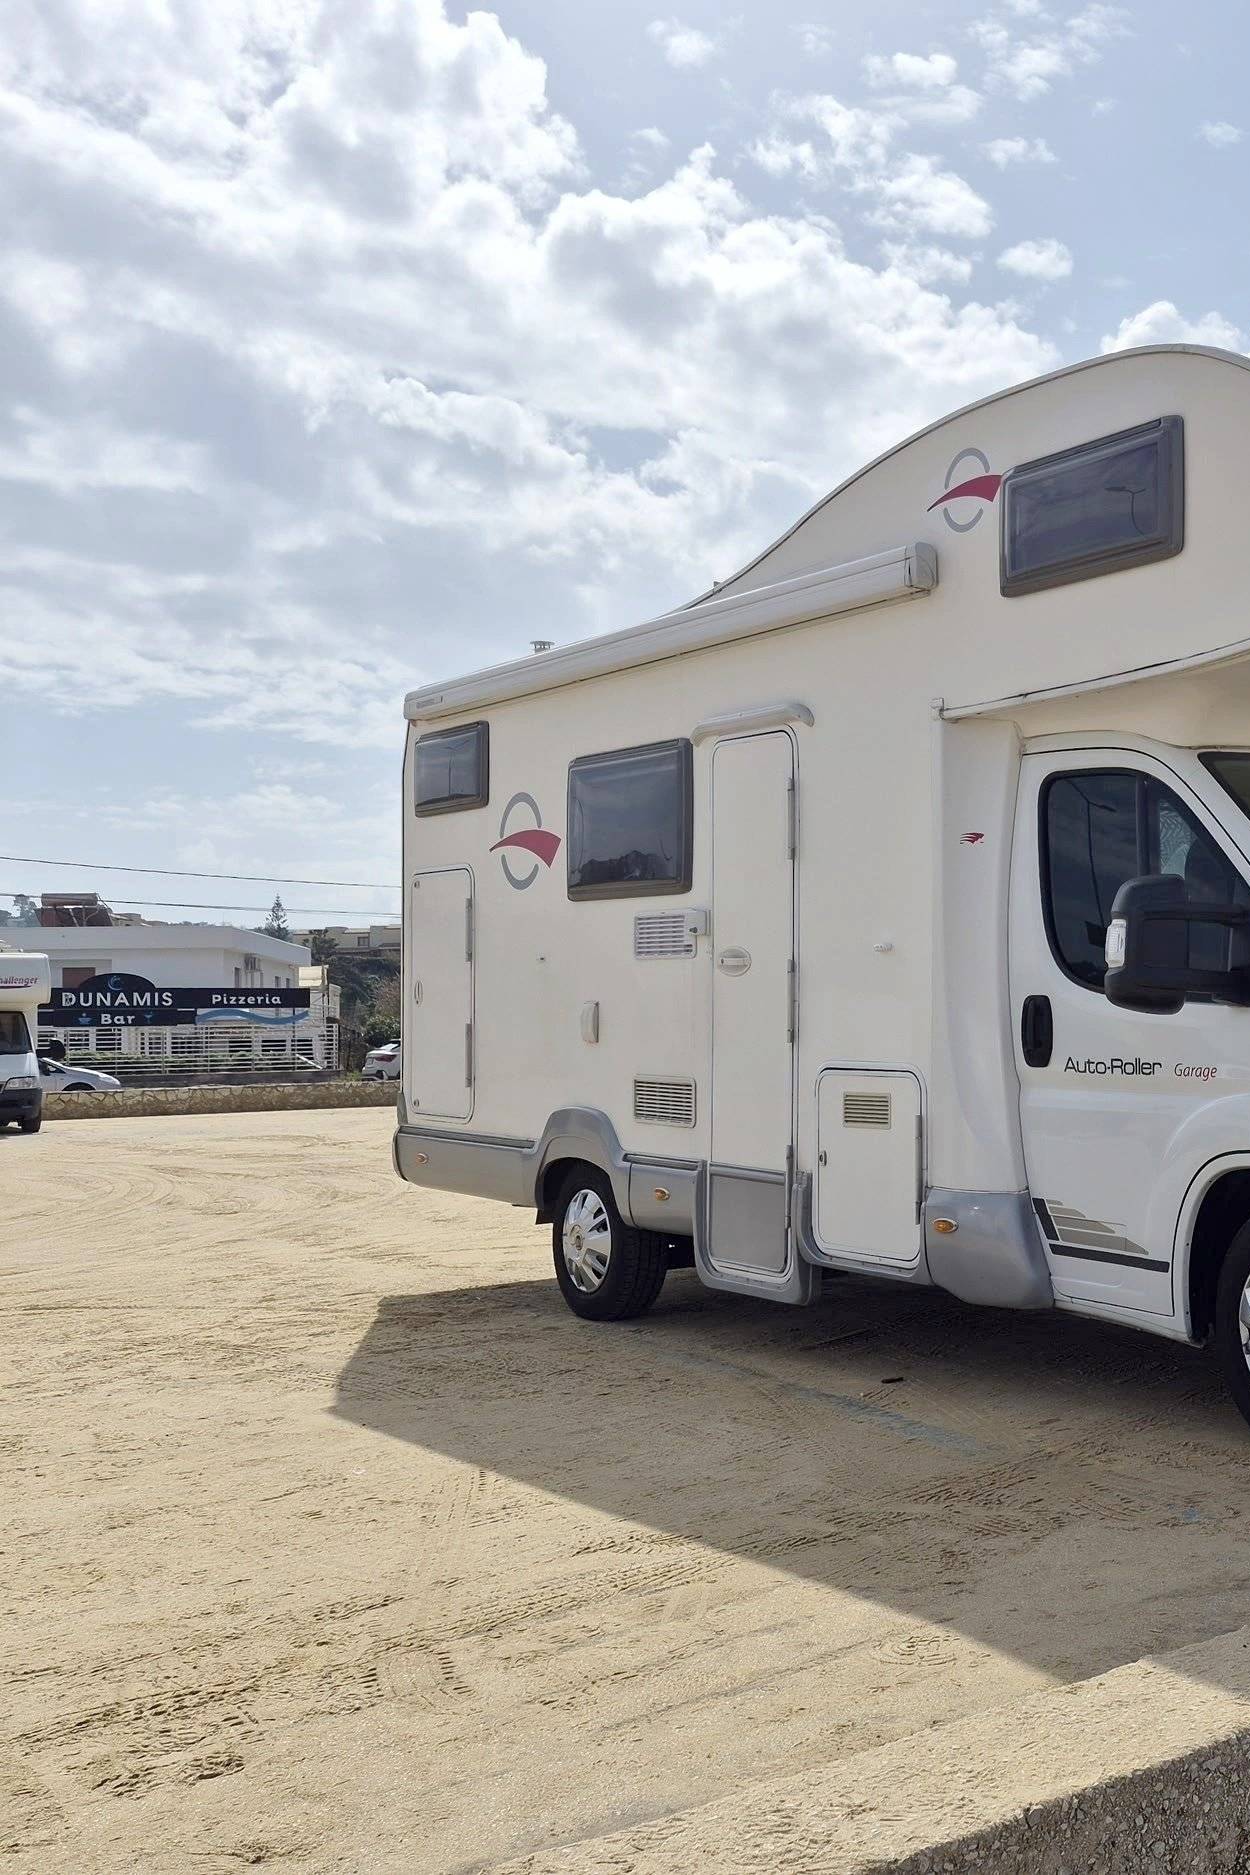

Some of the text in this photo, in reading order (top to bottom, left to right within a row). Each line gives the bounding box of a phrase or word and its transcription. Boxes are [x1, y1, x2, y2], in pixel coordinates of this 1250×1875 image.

[62, 991, 173, 1007] DUNAMIS
[212, 994, 282, 1005] Pizzeria
[100, 1013, 135, 1024] Bar
[1174, 1063, 1218, 1081] Garage
